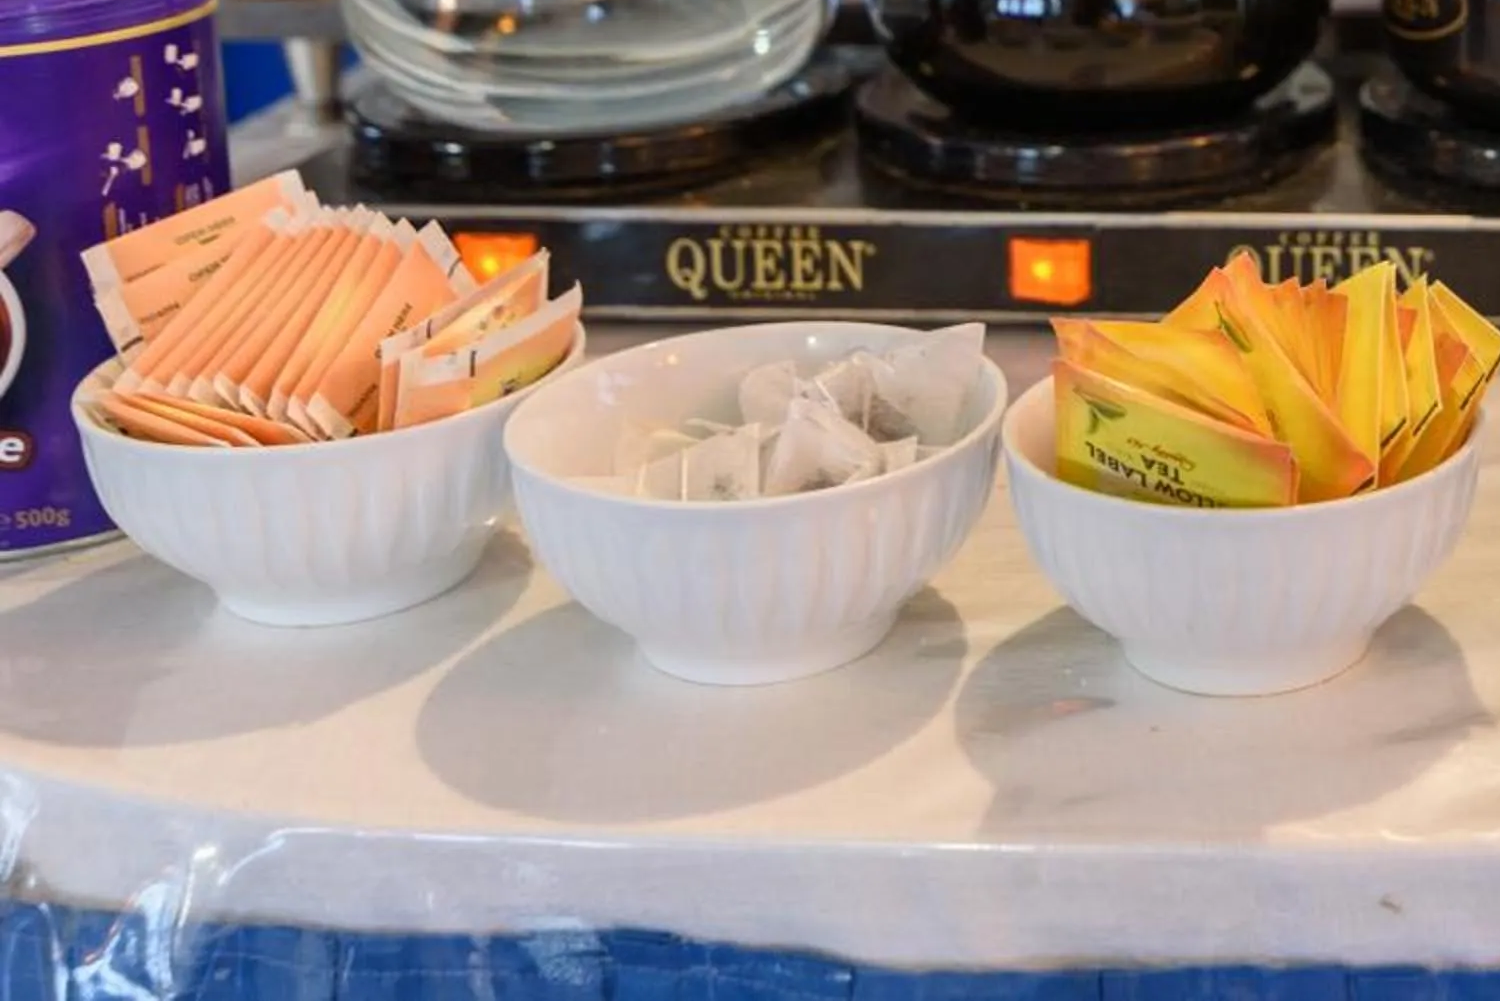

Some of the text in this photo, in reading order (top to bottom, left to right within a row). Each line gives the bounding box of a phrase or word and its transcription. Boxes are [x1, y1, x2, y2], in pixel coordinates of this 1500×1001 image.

[665, 237, 864, 299] QUEEN
[1085, 440, 1228, 510] LLOW LABEL
[1140, 454, 1185, 486] TEA
[15, 506, 71, 529] 500g
